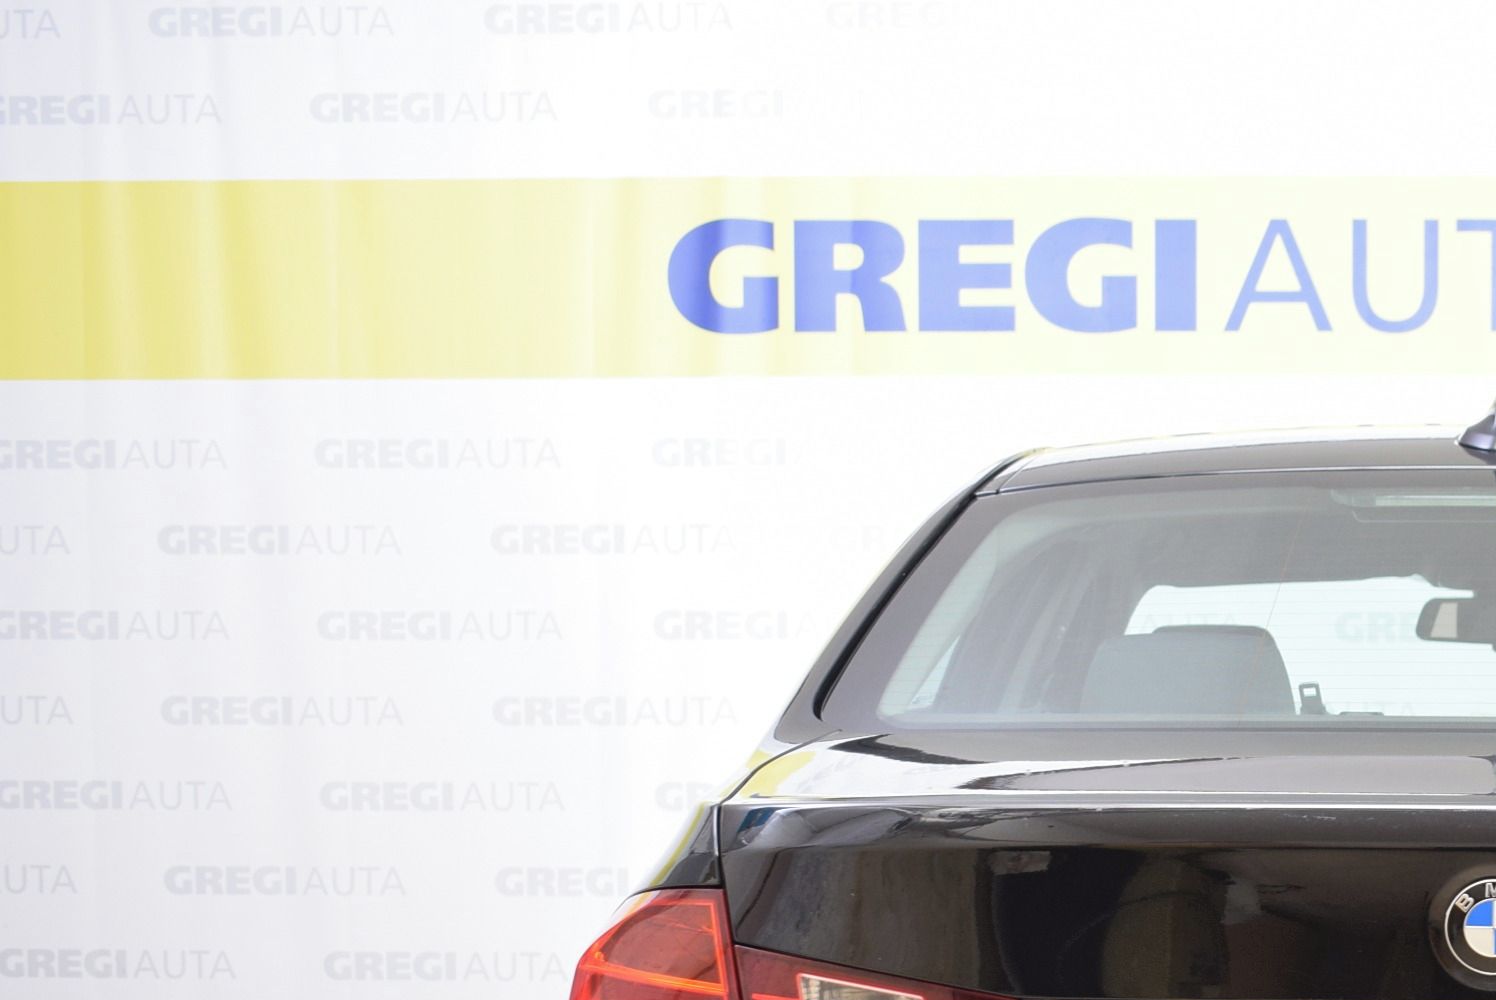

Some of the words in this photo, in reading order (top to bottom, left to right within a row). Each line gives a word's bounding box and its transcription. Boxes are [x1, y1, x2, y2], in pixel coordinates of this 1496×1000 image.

[147, 5, 394, 38] GREGIAUTA
[0, 93, 222, 125] REGIAUTA
[309, 90, 558, 123] GREGIAUTA
[313, 437, 562, 469] GREGIAUTA
[156, 524, 402, 556] GREGIAUTA
[317, 609, 563, 641] GREGIAUTA
[160, 695, 405, 728] GREGIAUTA
[319, 781, 565, 813] GREGIAUTA
[163, 865, 407, 898] GREGIAUTA
[323, 950, 568, 984] GREGIAUTA
